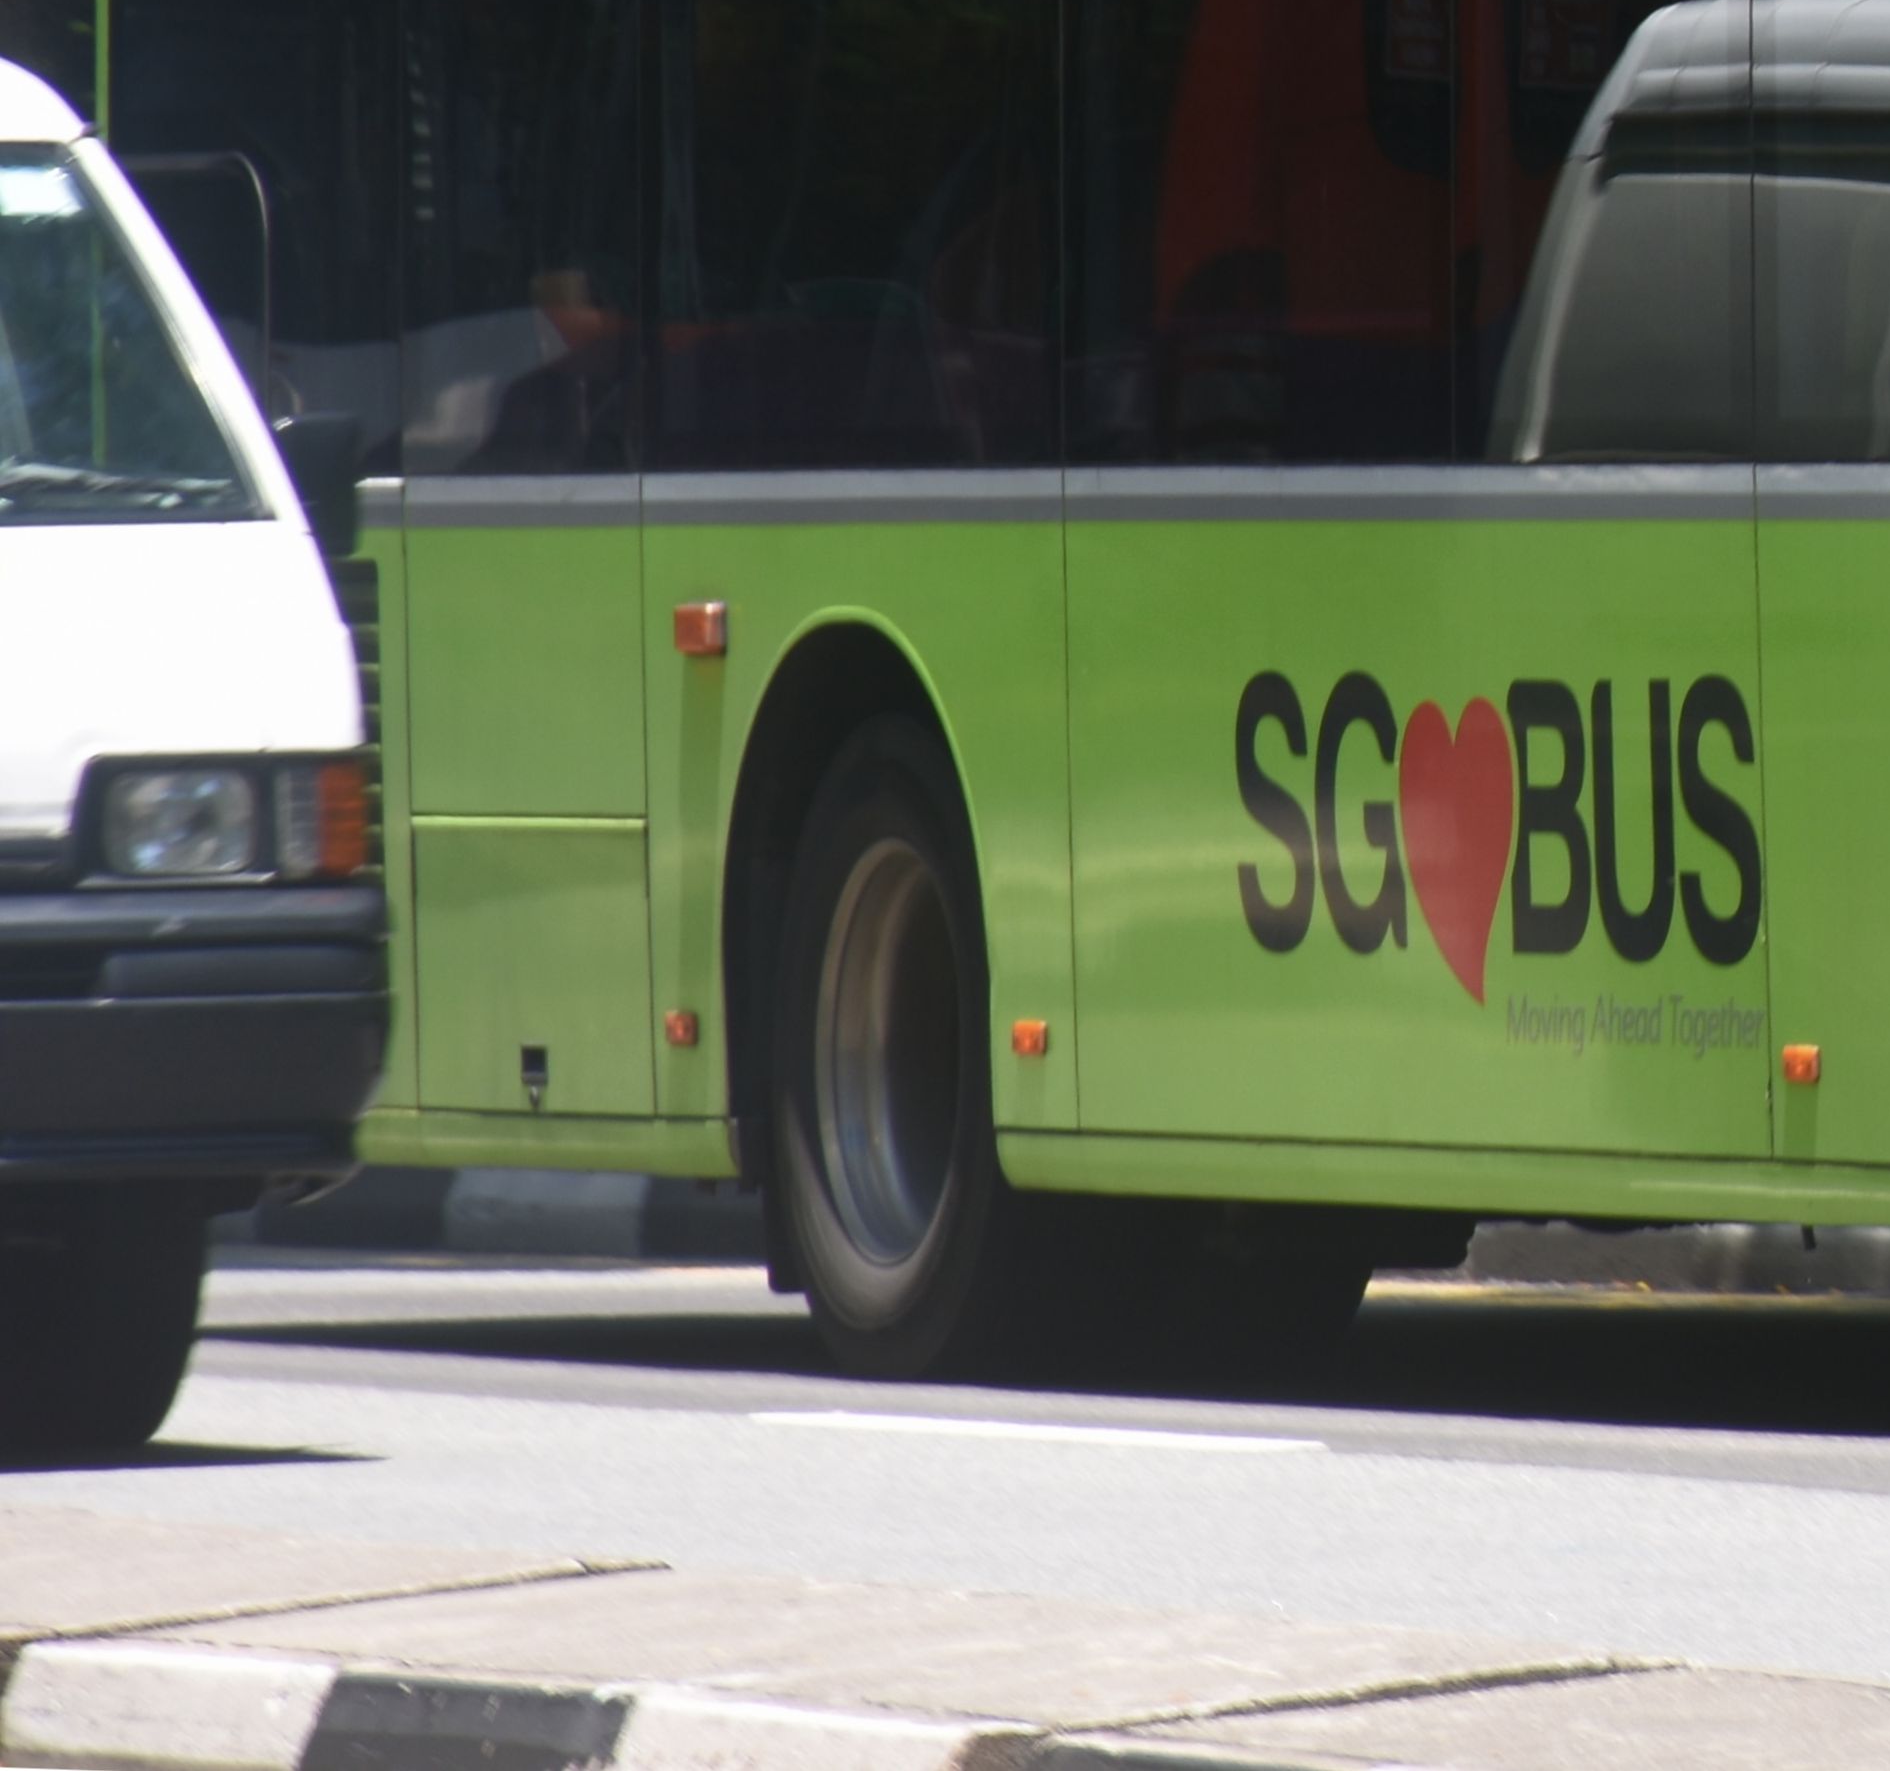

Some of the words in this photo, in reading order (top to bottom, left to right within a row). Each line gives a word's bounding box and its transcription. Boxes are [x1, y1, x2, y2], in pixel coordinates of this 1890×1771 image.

[1234, 669, 1408, 954] SG
[1506, 674, 1764, 966] BUS
[1506, 993, 1586, 1056] Moving
[1590, 993, 1664, 1047] Ahead
[1668, 993, 1766, 1061] Together
